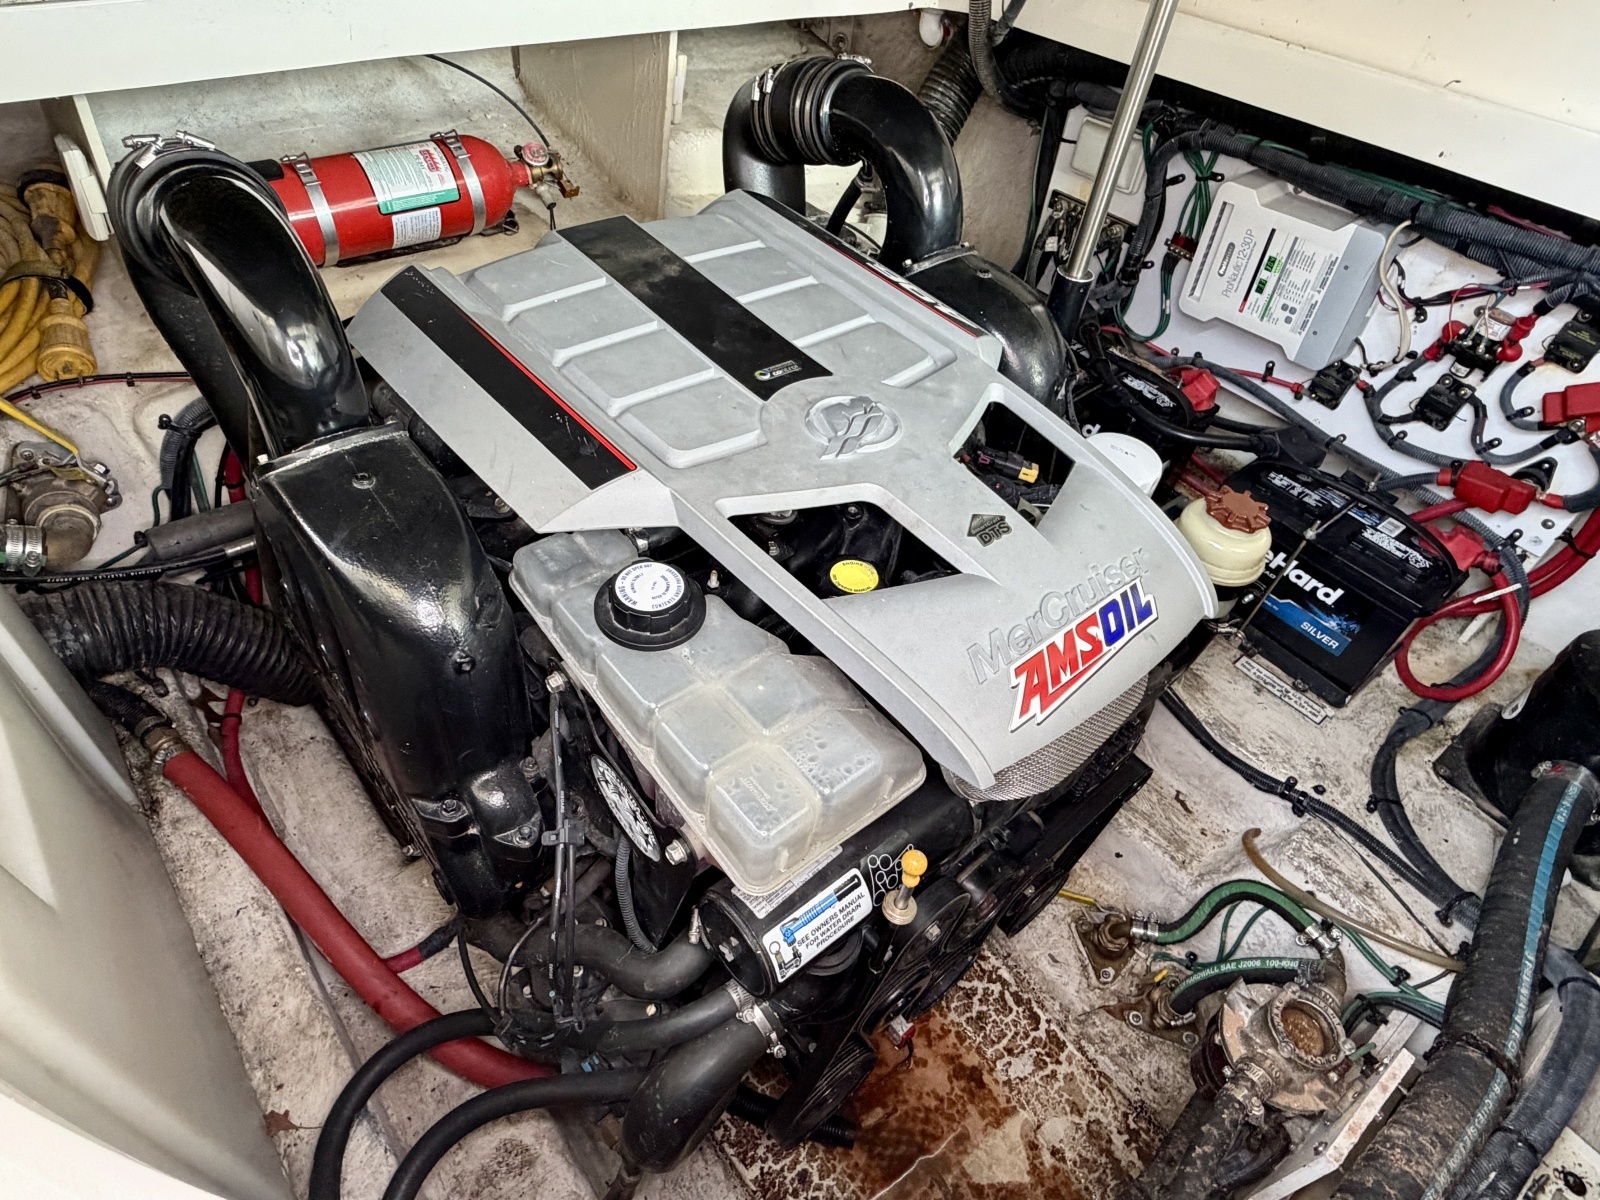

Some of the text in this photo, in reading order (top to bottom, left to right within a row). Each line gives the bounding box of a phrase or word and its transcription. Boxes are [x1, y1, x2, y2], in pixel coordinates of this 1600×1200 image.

[979, 522, 1010, 544] DTS
[1264, 549, 1345, 606] eHard
[618, 586, 637, 606] WARNING
[652, 597, 676, 609] CONTENTS
[966, 547, 1150, 685] MerCruiser
[1013, 582, 1154, 718] AMSOIL
[1300, 621, 1340, 649] SILVER
[797, 892, 866, 948] SEE OWNERS MANUAL
[805, 903, 862, 950] FOR WATER DRAIN
[816, 915, 855, 949] PROCEDURE
[1186, 967, 1220, 984] HARDWALL
[1220, 962, 1237, 972] SAE
[1237, 959, 1261, 969] J2006
